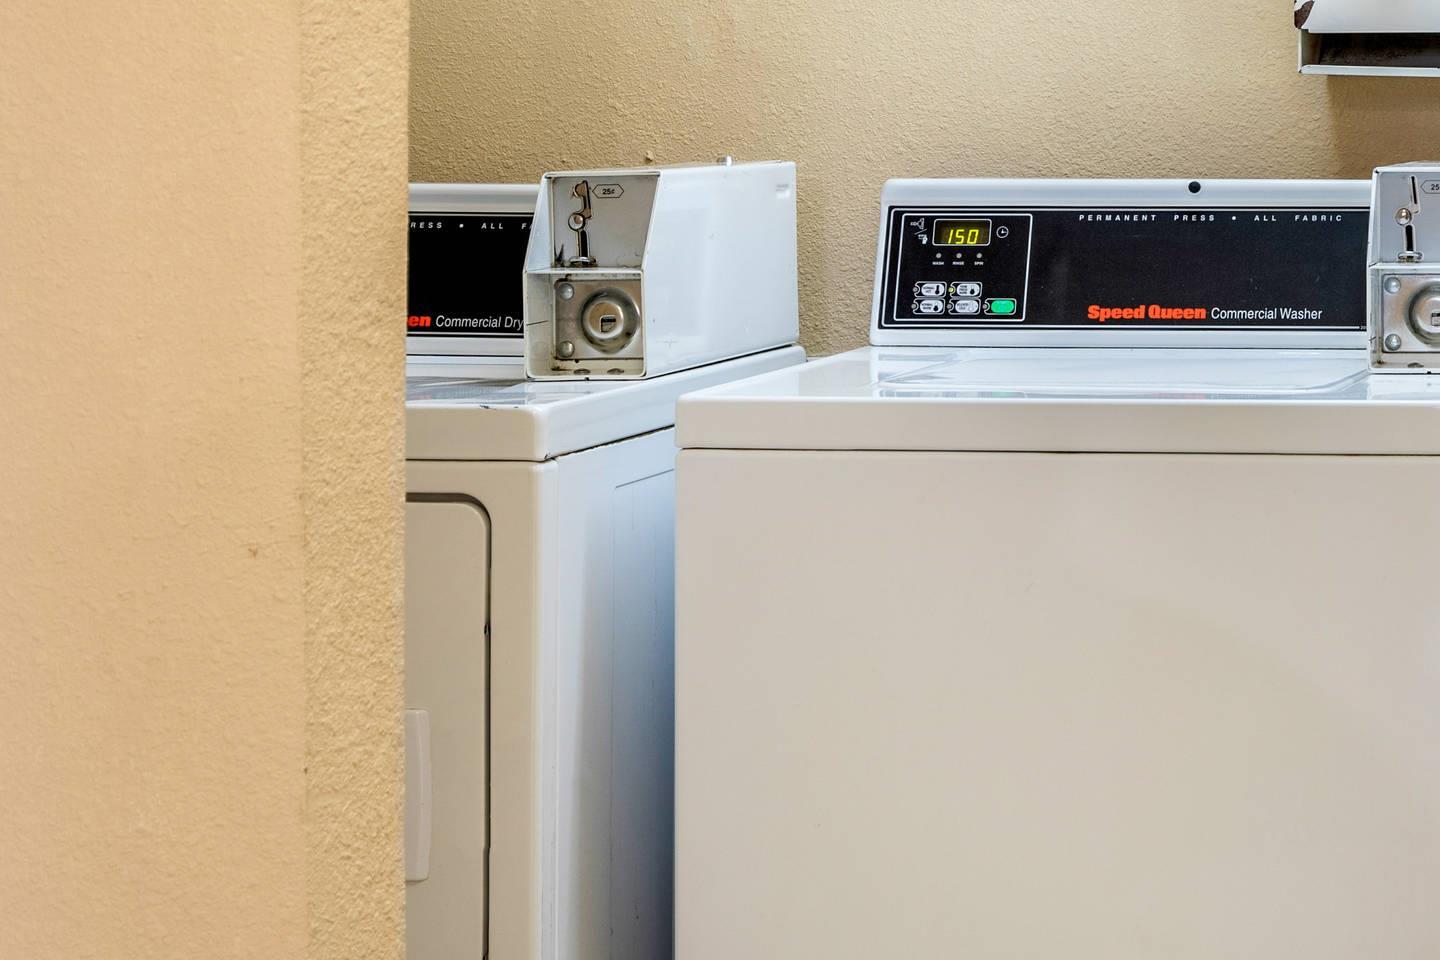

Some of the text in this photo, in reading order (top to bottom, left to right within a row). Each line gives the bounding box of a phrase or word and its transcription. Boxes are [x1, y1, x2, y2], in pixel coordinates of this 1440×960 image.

[410, 221, 442, 229] RESS
[948, 229, 979, 245] 150
[1088, 304, 1323, 322] Speed Queen Commercial Washer
[435, 315, 501, 328] Commercial
[504, 316, 524, 331] Dry
